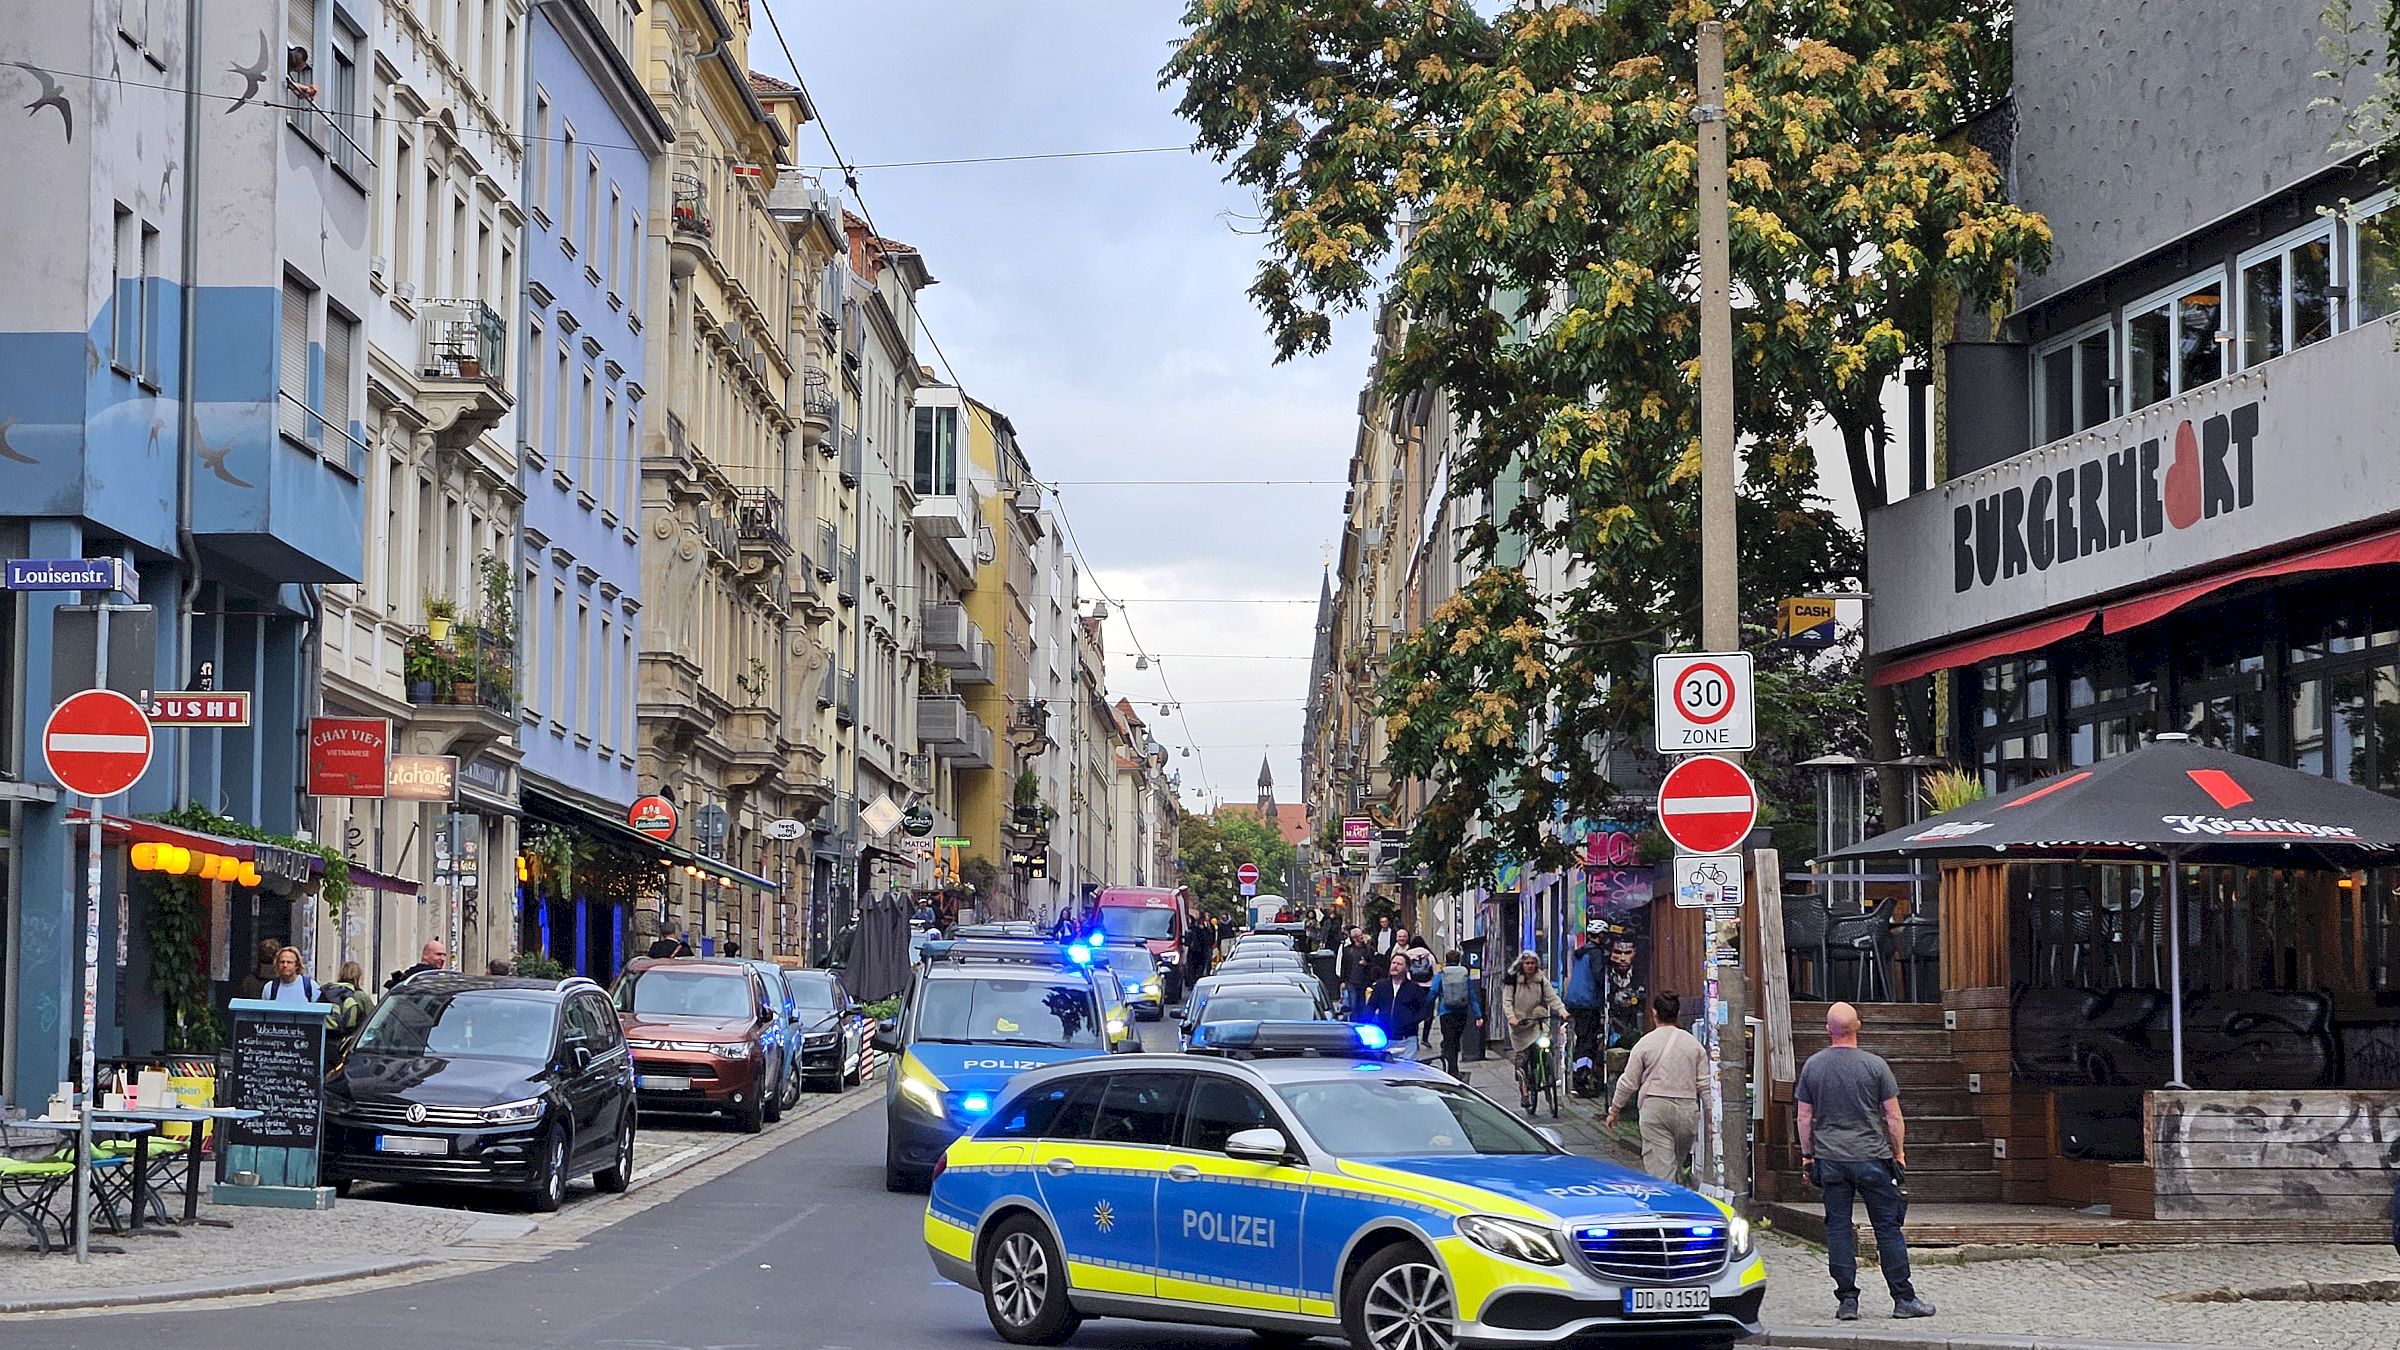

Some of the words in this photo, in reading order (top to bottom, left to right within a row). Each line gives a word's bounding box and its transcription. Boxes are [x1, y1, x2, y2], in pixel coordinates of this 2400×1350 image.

[14, 567, 107, 584] Louisenstr.
[1795, 605, 1831, 618] CASH
[1686, 679, 1722, 708] 30
[149, 701, 237, 717] SUSHI
[313, 728, 348, 747] CHAY
[351, 729, 383, 748] VIET
[1682, 728, 1729, 744] ZONE
[326, 749, 370, 757] VIETNAMESE
[2161, 814, 2357, 838] Köstritzer
[1011, 853, 1028, 865] sky
[1470, 952, 1479, 966] P
[1183, 1208, 1276, 1249] POLIZEI
[1635, 1291, 1655, 1309] DD
[1664, 1291, 1674, 1309] Q
[1676, 1289, 1708, 1309] 1512
